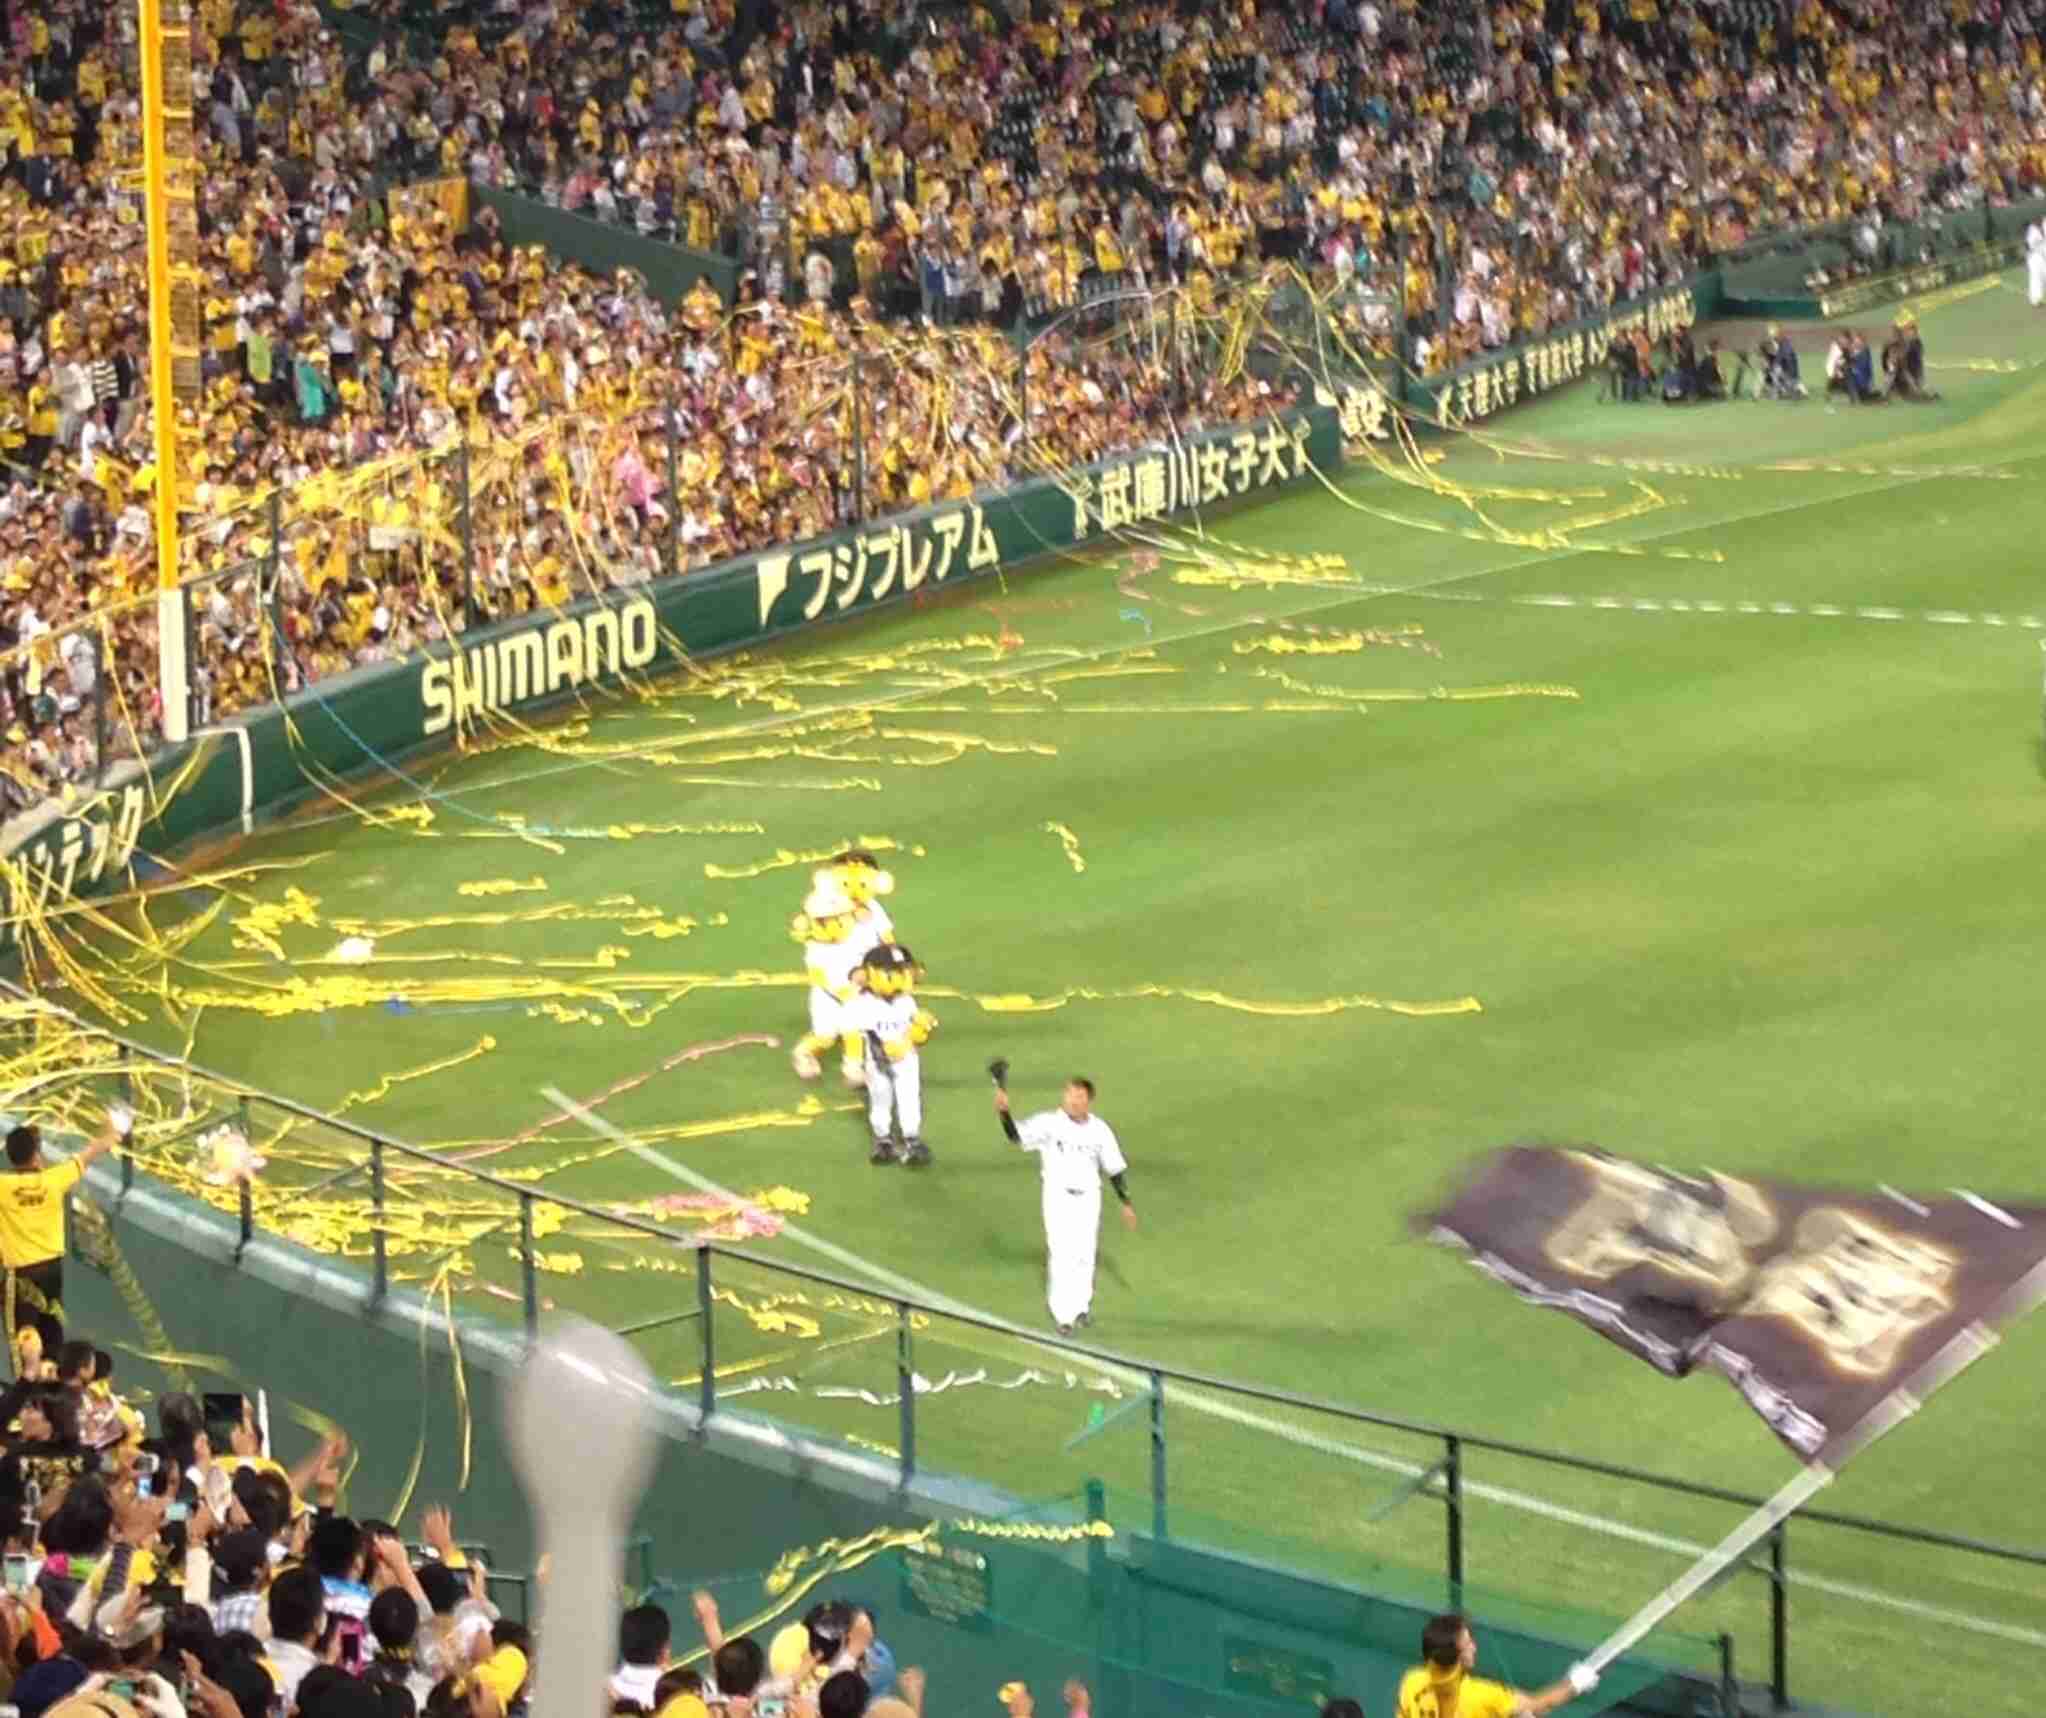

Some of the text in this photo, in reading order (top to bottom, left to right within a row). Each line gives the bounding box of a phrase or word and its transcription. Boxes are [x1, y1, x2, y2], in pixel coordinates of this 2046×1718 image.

[800, 504, 999, 620] フジプレアム
[422, 600, 656, 736] SHIMANO
